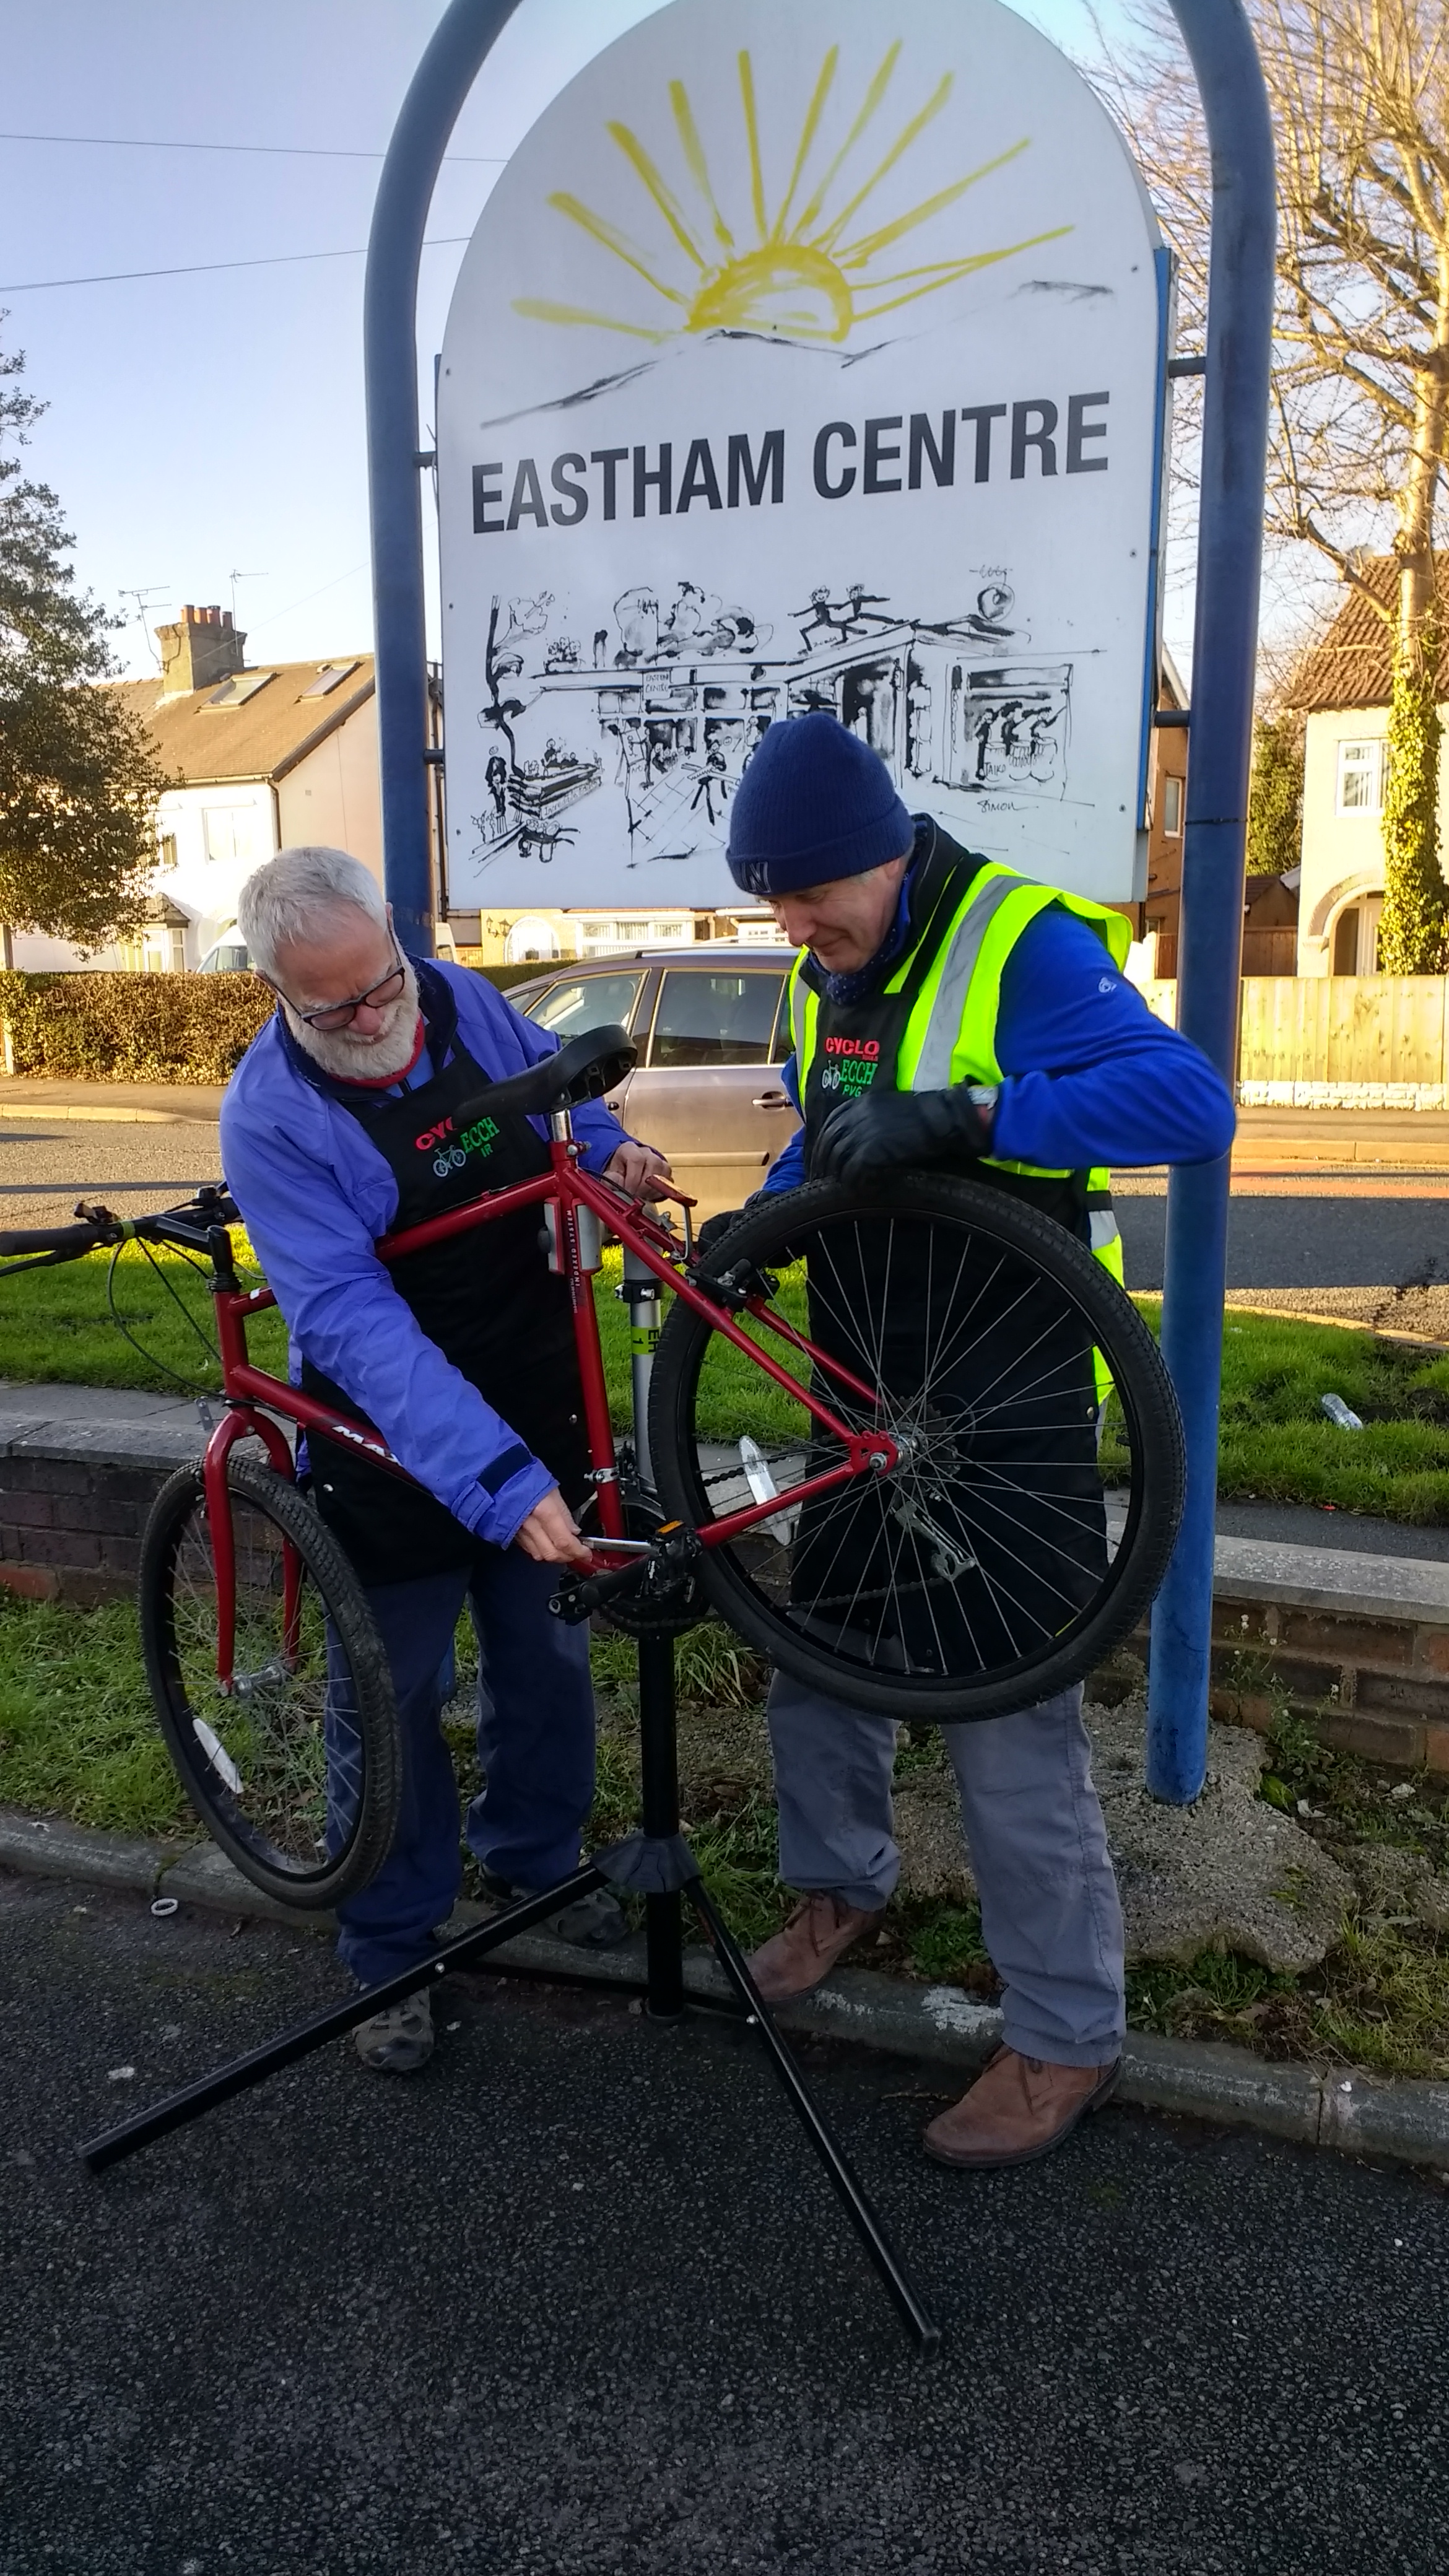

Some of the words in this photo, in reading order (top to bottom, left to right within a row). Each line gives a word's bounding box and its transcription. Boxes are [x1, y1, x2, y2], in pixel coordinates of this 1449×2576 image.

[471, 429, 785, 534] EASTHAM
[813, 391, 1110, 500] CENTRE
[985, 762, 1006, 776] TAIKO
[825, 1037, 880, 1056] CYCLO
[840, 1059, 878, 1085] ECCH
[842, 1084, 863, 1097] PVG
[460, 1116, 500, 1154] ECCH
[480, 1143, 494, 1157] IR
[566, 1209, 575, 1243] SYSTEM
[571, 1248, 581, 1287] INDEXED
